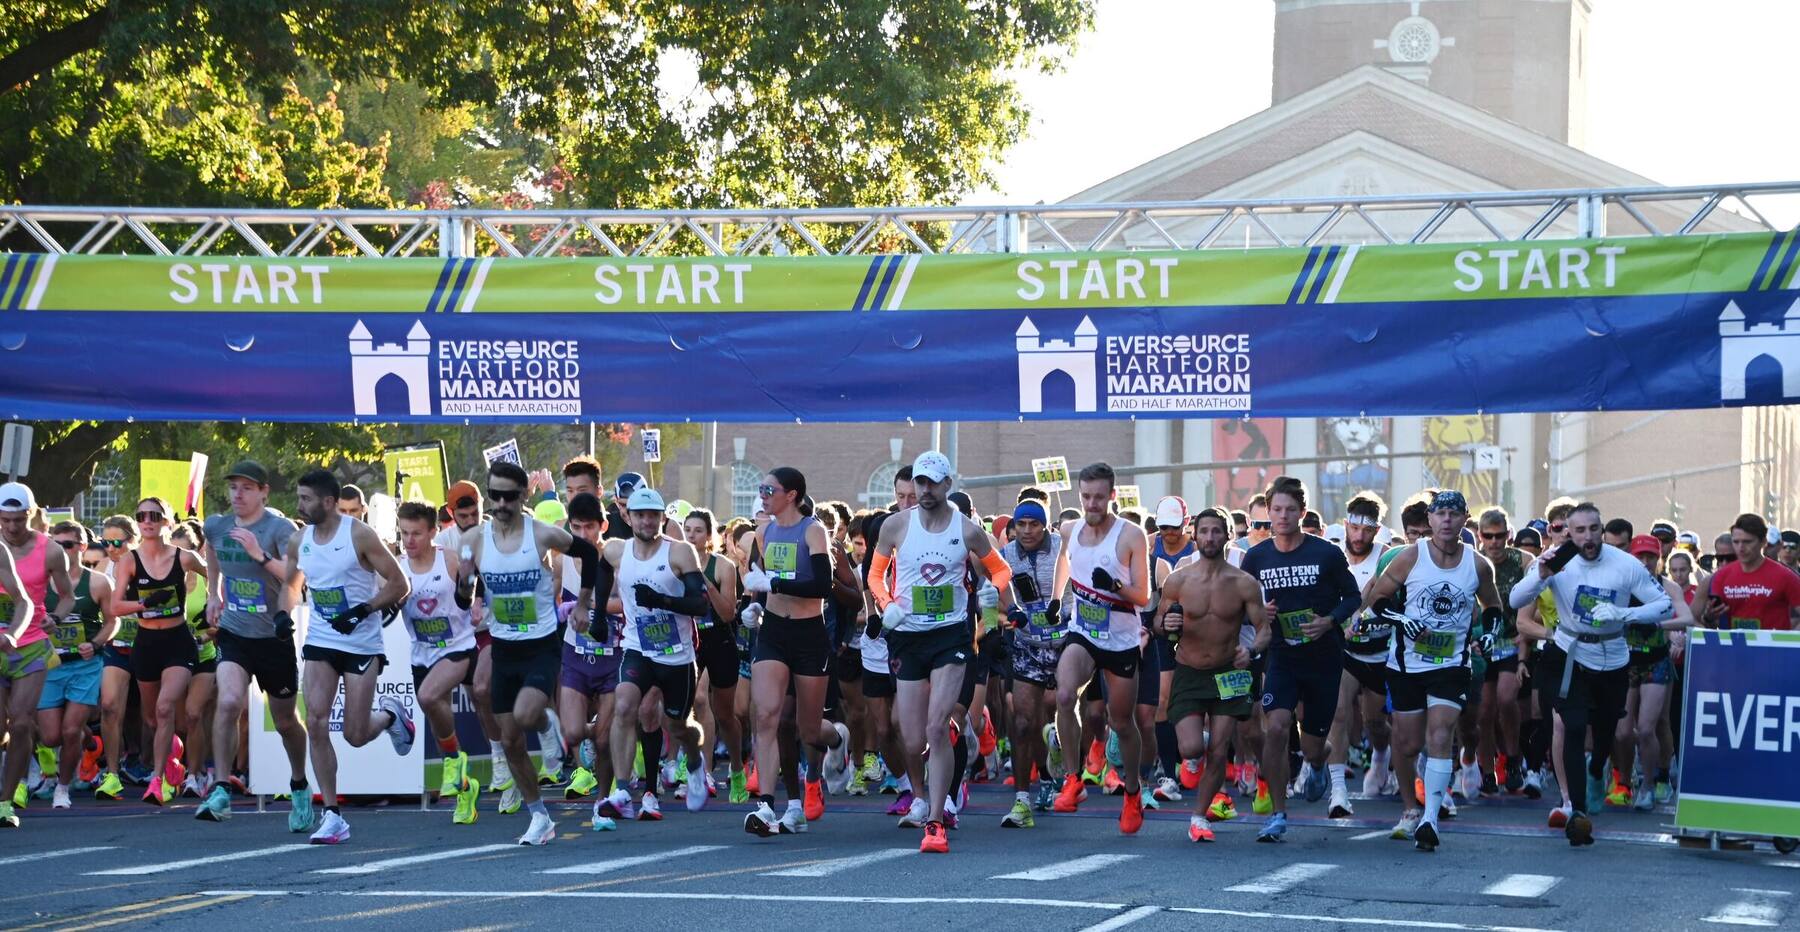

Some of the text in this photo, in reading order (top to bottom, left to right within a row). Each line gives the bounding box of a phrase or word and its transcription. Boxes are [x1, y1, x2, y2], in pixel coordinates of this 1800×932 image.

[1453, 246, 1626, 292] START
[169, 264, 330, 304] START
[594, 264, 752, 304] START
[1016, 257, 1180, 302] START
[439, 340, 579, 360] EVERSOURCE
[1106, 334, 1250, 355] EVERSOURCE
[439, 360, 580, 379] HARTFORD
[1106, 354, 1250, 374] HARTFORD
[440, 379, 580, 398] MARATHON
[1107, 374, 1250, 394] MARATHON
[445, 403, 577, 413] AND HALF MARATHON
[1111, 397, 1247, 409] AND HALF MARATHON
[485, 571, 541, 584] CENTRAL
[1260, 564, 1320, 580] STATE PENN
[923, 588, 945, 601] 124
[504, 600, 525, 612] 123
[1435, 601, 1451, 610] 786
